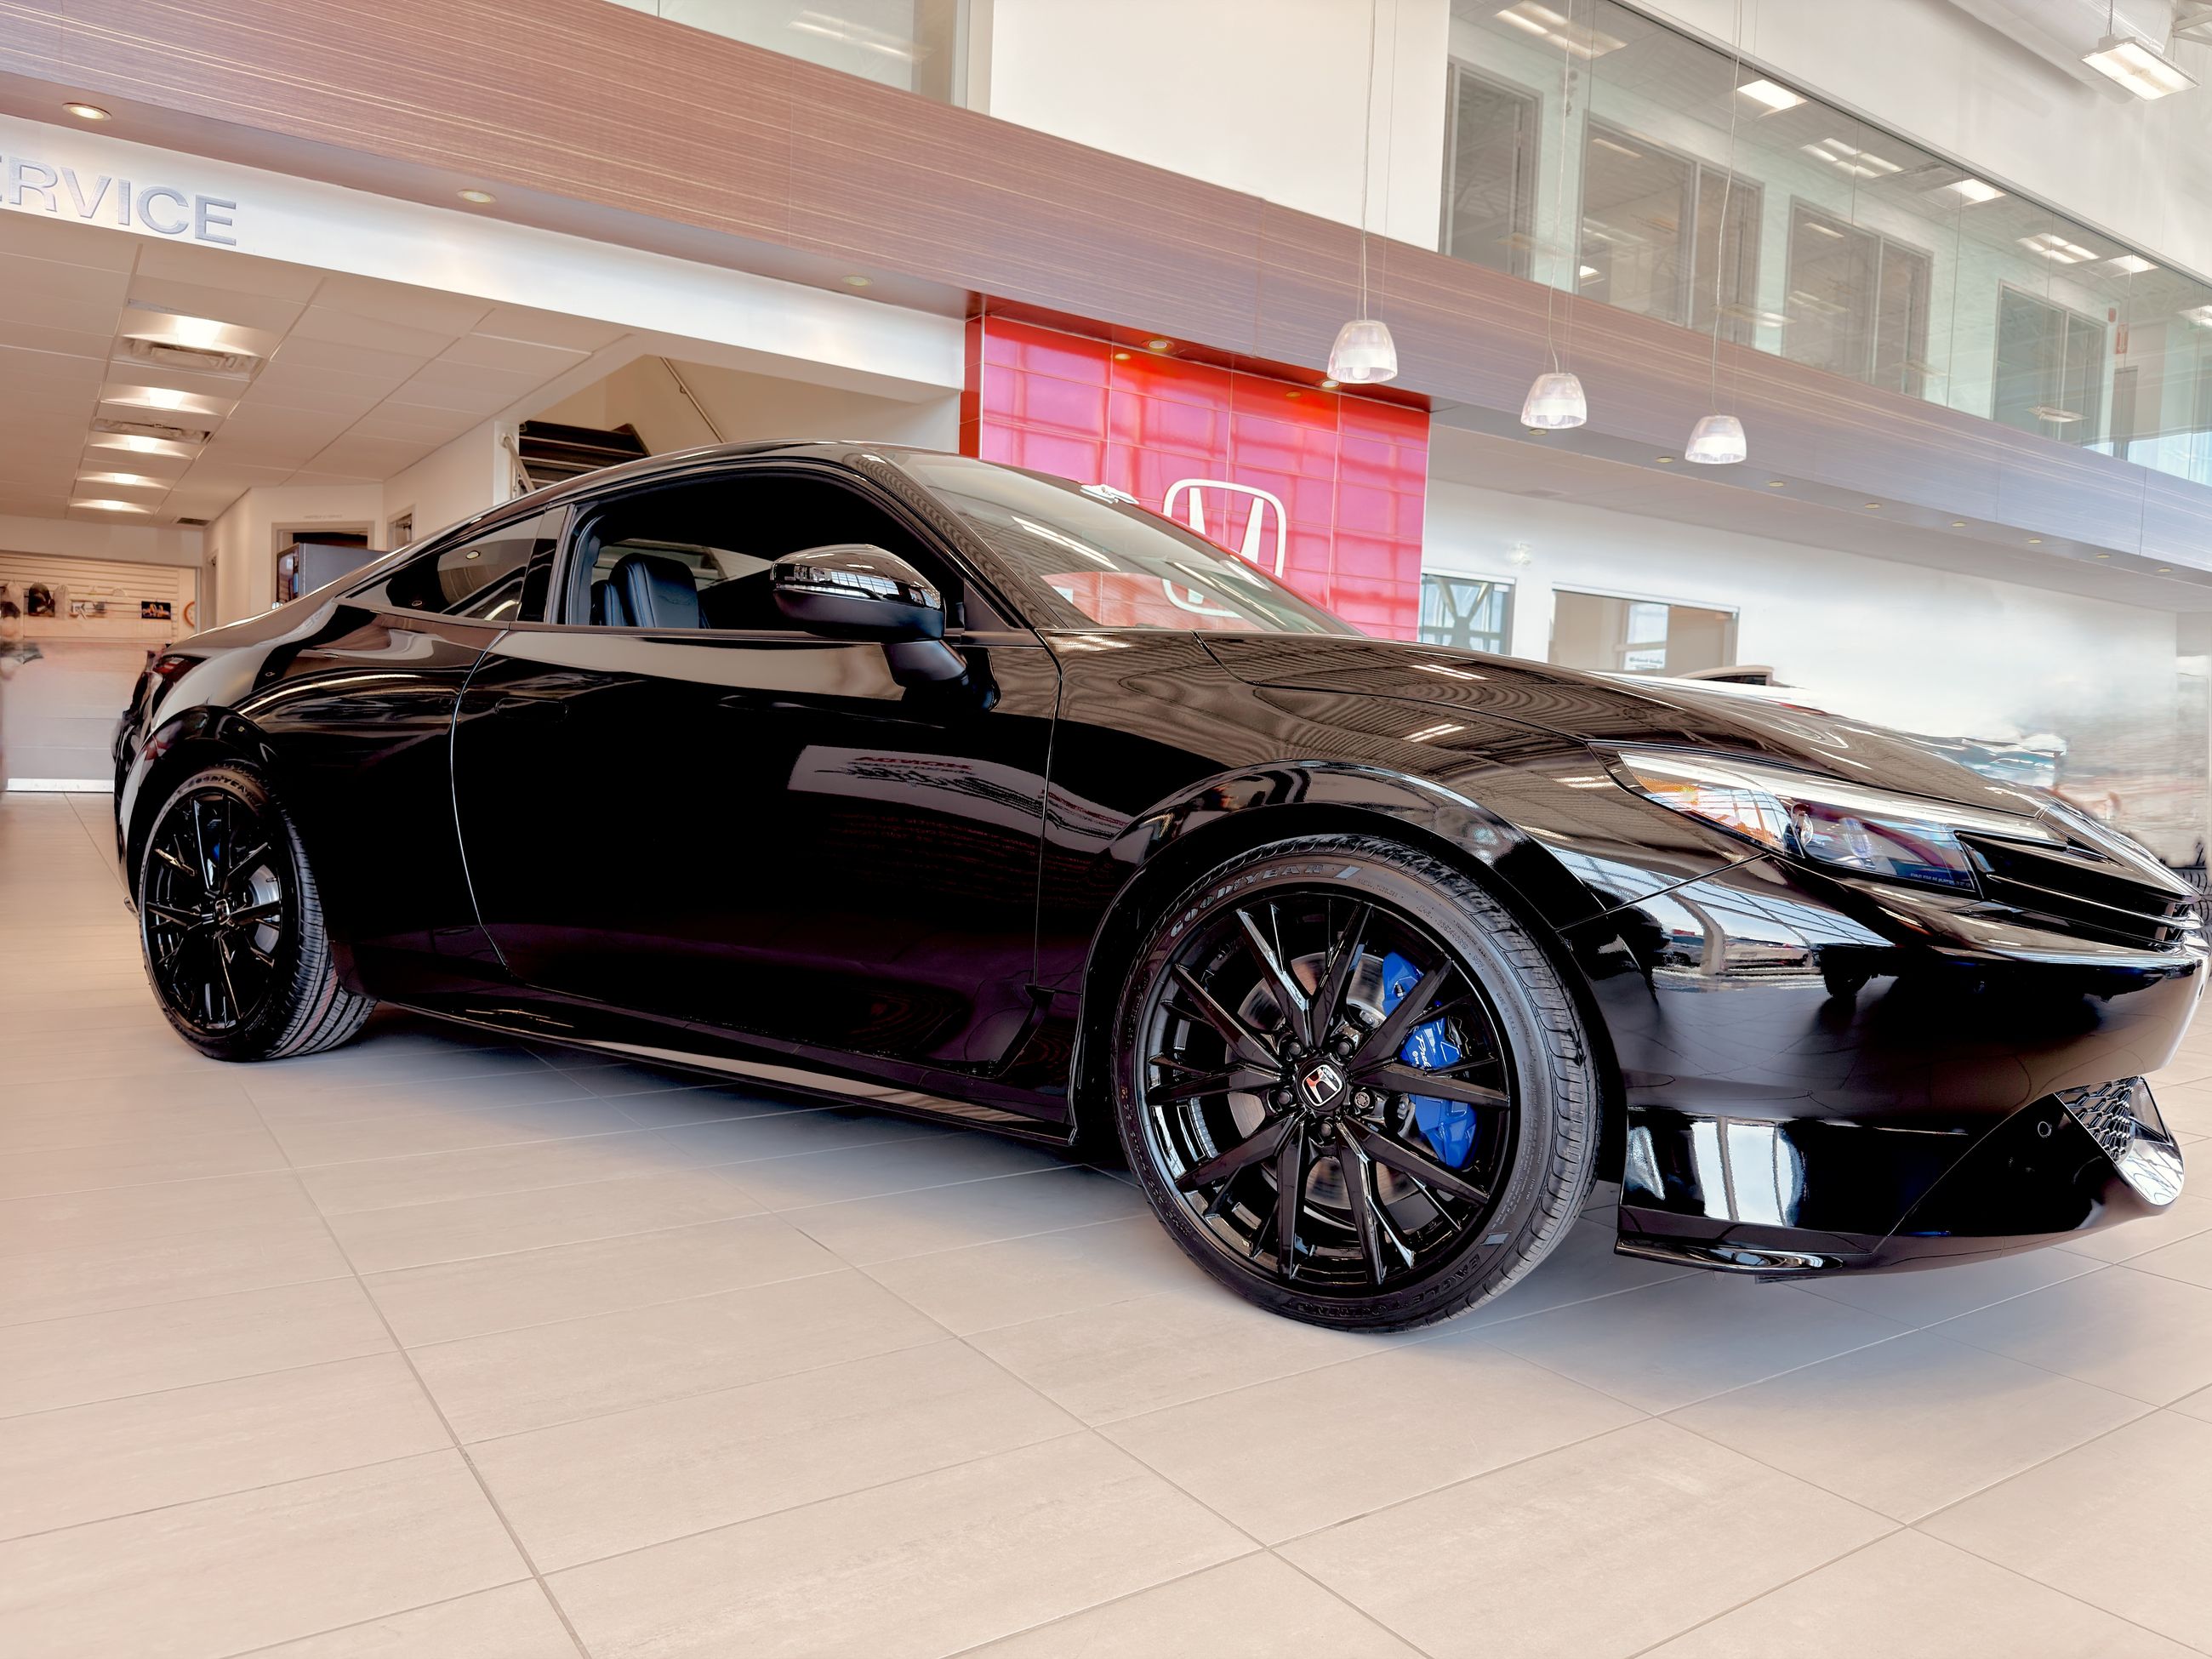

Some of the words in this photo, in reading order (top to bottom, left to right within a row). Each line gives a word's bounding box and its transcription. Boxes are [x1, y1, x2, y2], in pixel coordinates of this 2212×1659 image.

[0, 156, 237, 247] RVICE
[1171, 864, 1324, 938] GOODYEAR
[1412, 1253, 1482, 1303] EAGLE
